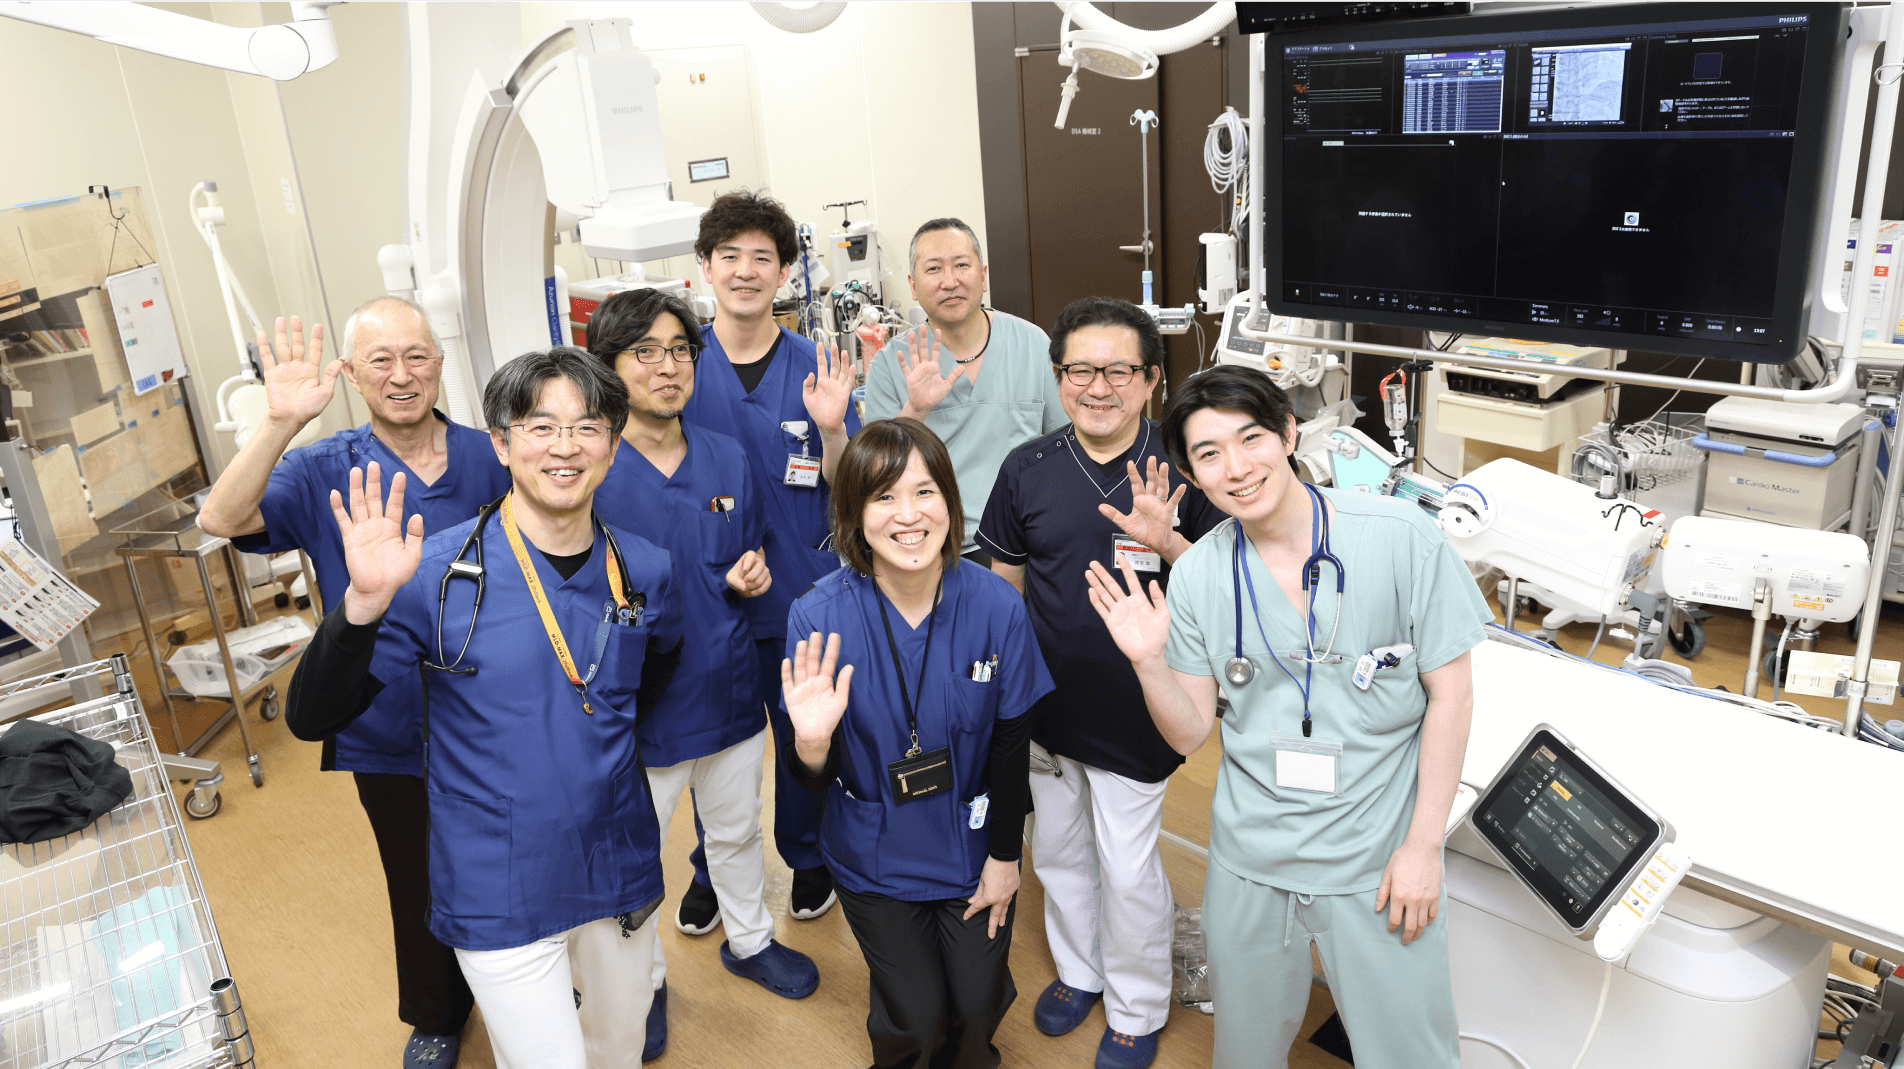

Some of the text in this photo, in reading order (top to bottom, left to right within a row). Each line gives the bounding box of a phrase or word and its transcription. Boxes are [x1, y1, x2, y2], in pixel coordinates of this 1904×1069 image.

[1778, 15, 1808, 24] PHILIPS
[612, 105, 643, 115] PHILIPS
[1071, 127, 1081, 135] DSA
[1745, 479, 1800, 495] Cardio Master
